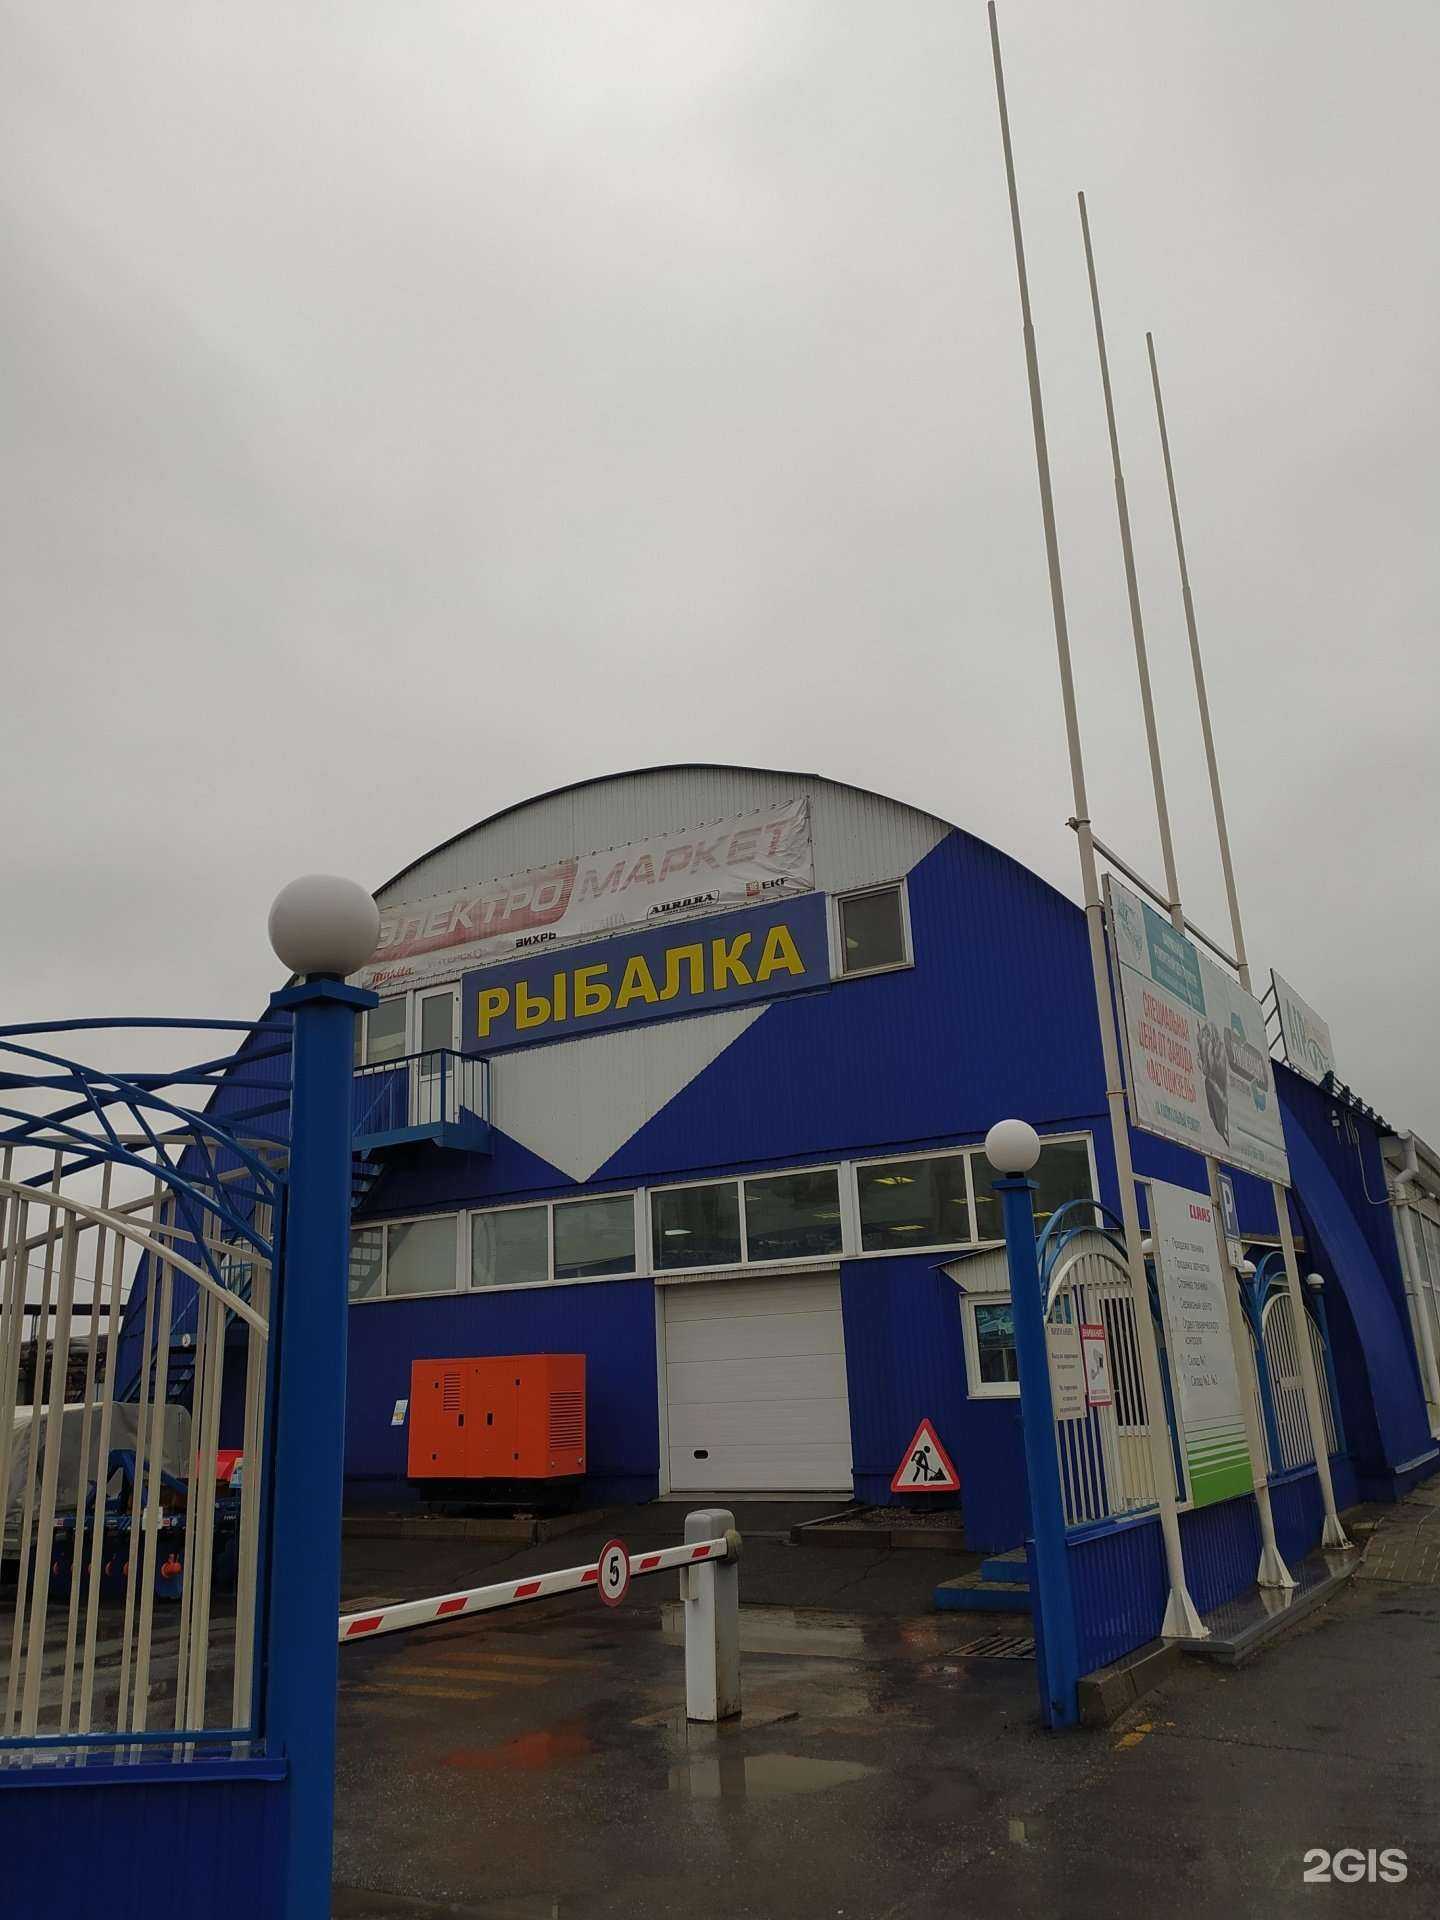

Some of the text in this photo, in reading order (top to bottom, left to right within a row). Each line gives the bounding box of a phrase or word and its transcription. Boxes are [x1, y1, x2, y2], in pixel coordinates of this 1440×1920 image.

[762, 877, 789, 890] EKF
[650, 893, 716, 914] AURORA
[515, 932, 557, 948] ВИХРЬ
[477, 924, 807, 1038] РЫБАЛКА
[1189, 1204, 1211, 1223] CLAAS
[609, 1556, 620, 1587] 5
